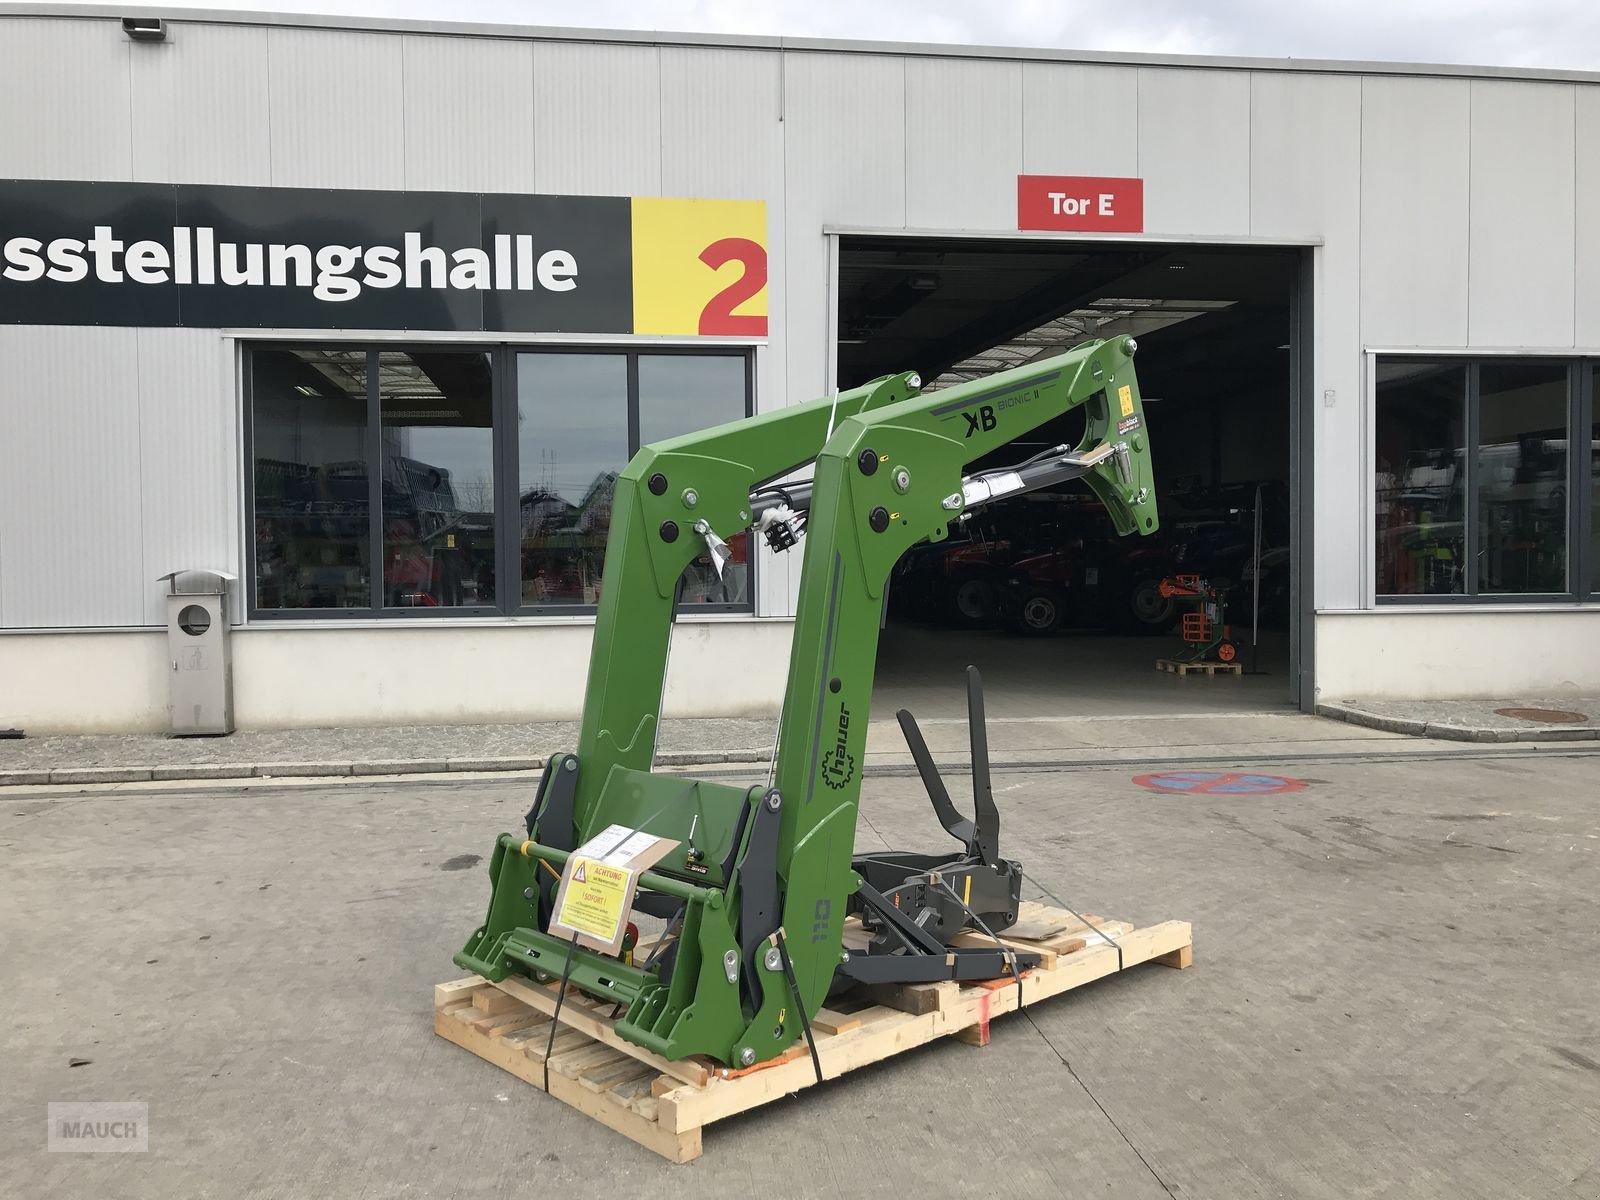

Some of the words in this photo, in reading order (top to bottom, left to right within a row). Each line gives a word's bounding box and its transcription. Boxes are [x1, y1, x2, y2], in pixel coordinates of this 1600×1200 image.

[1047, 192, 1091, 215] Tor
[1098, 193, 1115, 216] E
[697, 237, 769, 337] 2
[961, 405, 997, 438] XB
[998, 392, 1032, 411] BIONIC
[829, 701, 850, 776] hauer
[594, 867, 623, 881] ACHTUNG
